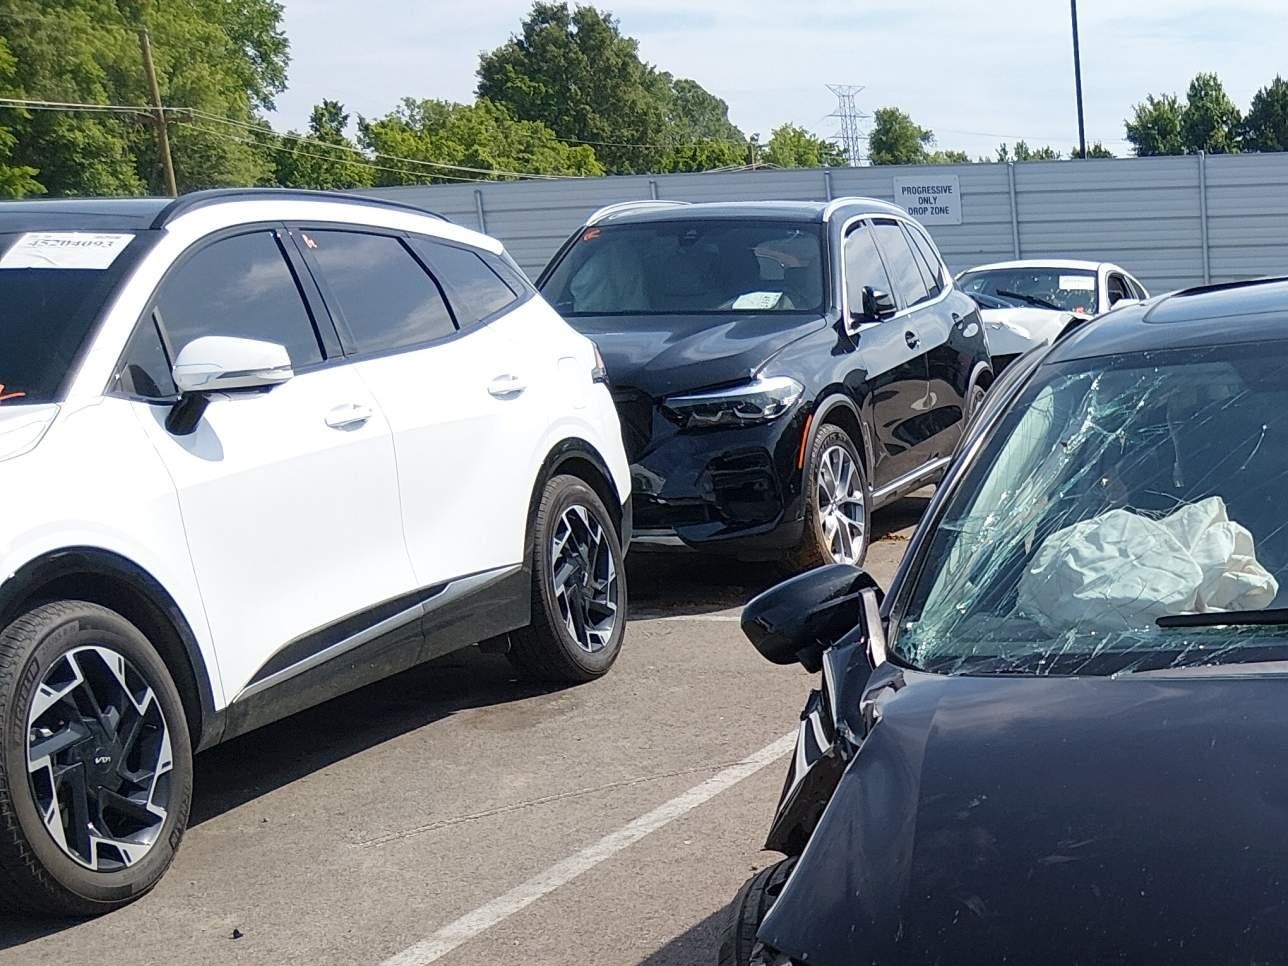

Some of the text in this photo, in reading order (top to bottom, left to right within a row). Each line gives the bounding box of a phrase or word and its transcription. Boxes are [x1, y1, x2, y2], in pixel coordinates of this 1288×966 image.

[901, 185, 953, 196] PROGRESSIVE
[918, 196, 938, 205] ONLY
[908, 206, 950, 215] DROP ZONE
